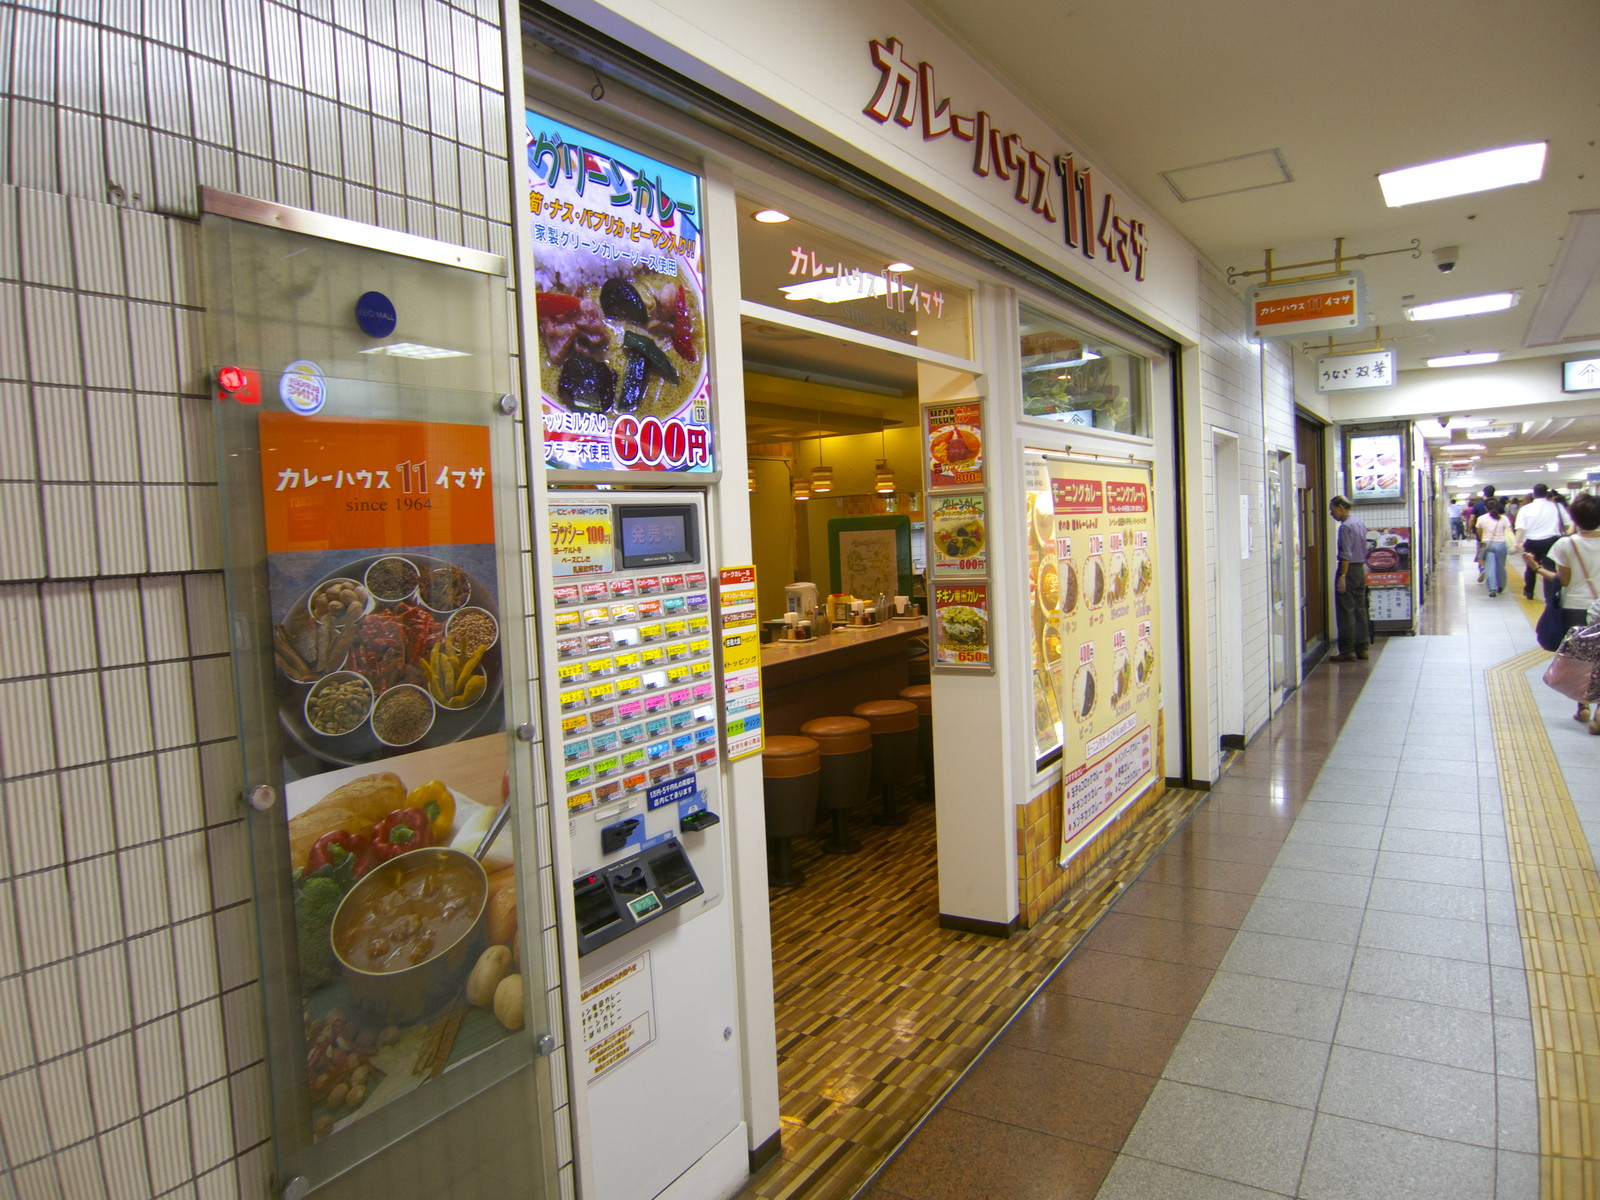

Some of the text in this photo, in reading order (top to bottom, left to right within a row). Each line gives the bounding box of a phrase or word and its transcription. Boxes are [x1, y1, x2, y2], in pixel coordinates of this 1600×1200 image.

[862, 37, 1148, 281] カレーハウス 11 イマサ
[532, 130, 695, 221] グリーンカレー
[531, 222, 677, 276] 家製グリーンカレーソース使用
[789, 246, 878, 299] カレーハウス
[910, 283, 944, 320] イマサ
[1260, 302, 1305, 316] カレーハウス
[1325, 295, 1351, 306] イマサ
[1322, 361, 1386, 381] うなぎ 双葉
[542, 412, 608, 433] ッツミルク入り
[614, 417, 708, 463] 600円
[275, 460, 486, 494] カレーハウス 11 イマサ
[1053, 483, 1145, 503] モーニングカレー モーニングプレート
[346, 498, 433, 512] since 1964
[551, 522, 584, 545] ラッシー
[632, 523, 675, 545] 発売中
[727, 656, 757, 668] トッピング
